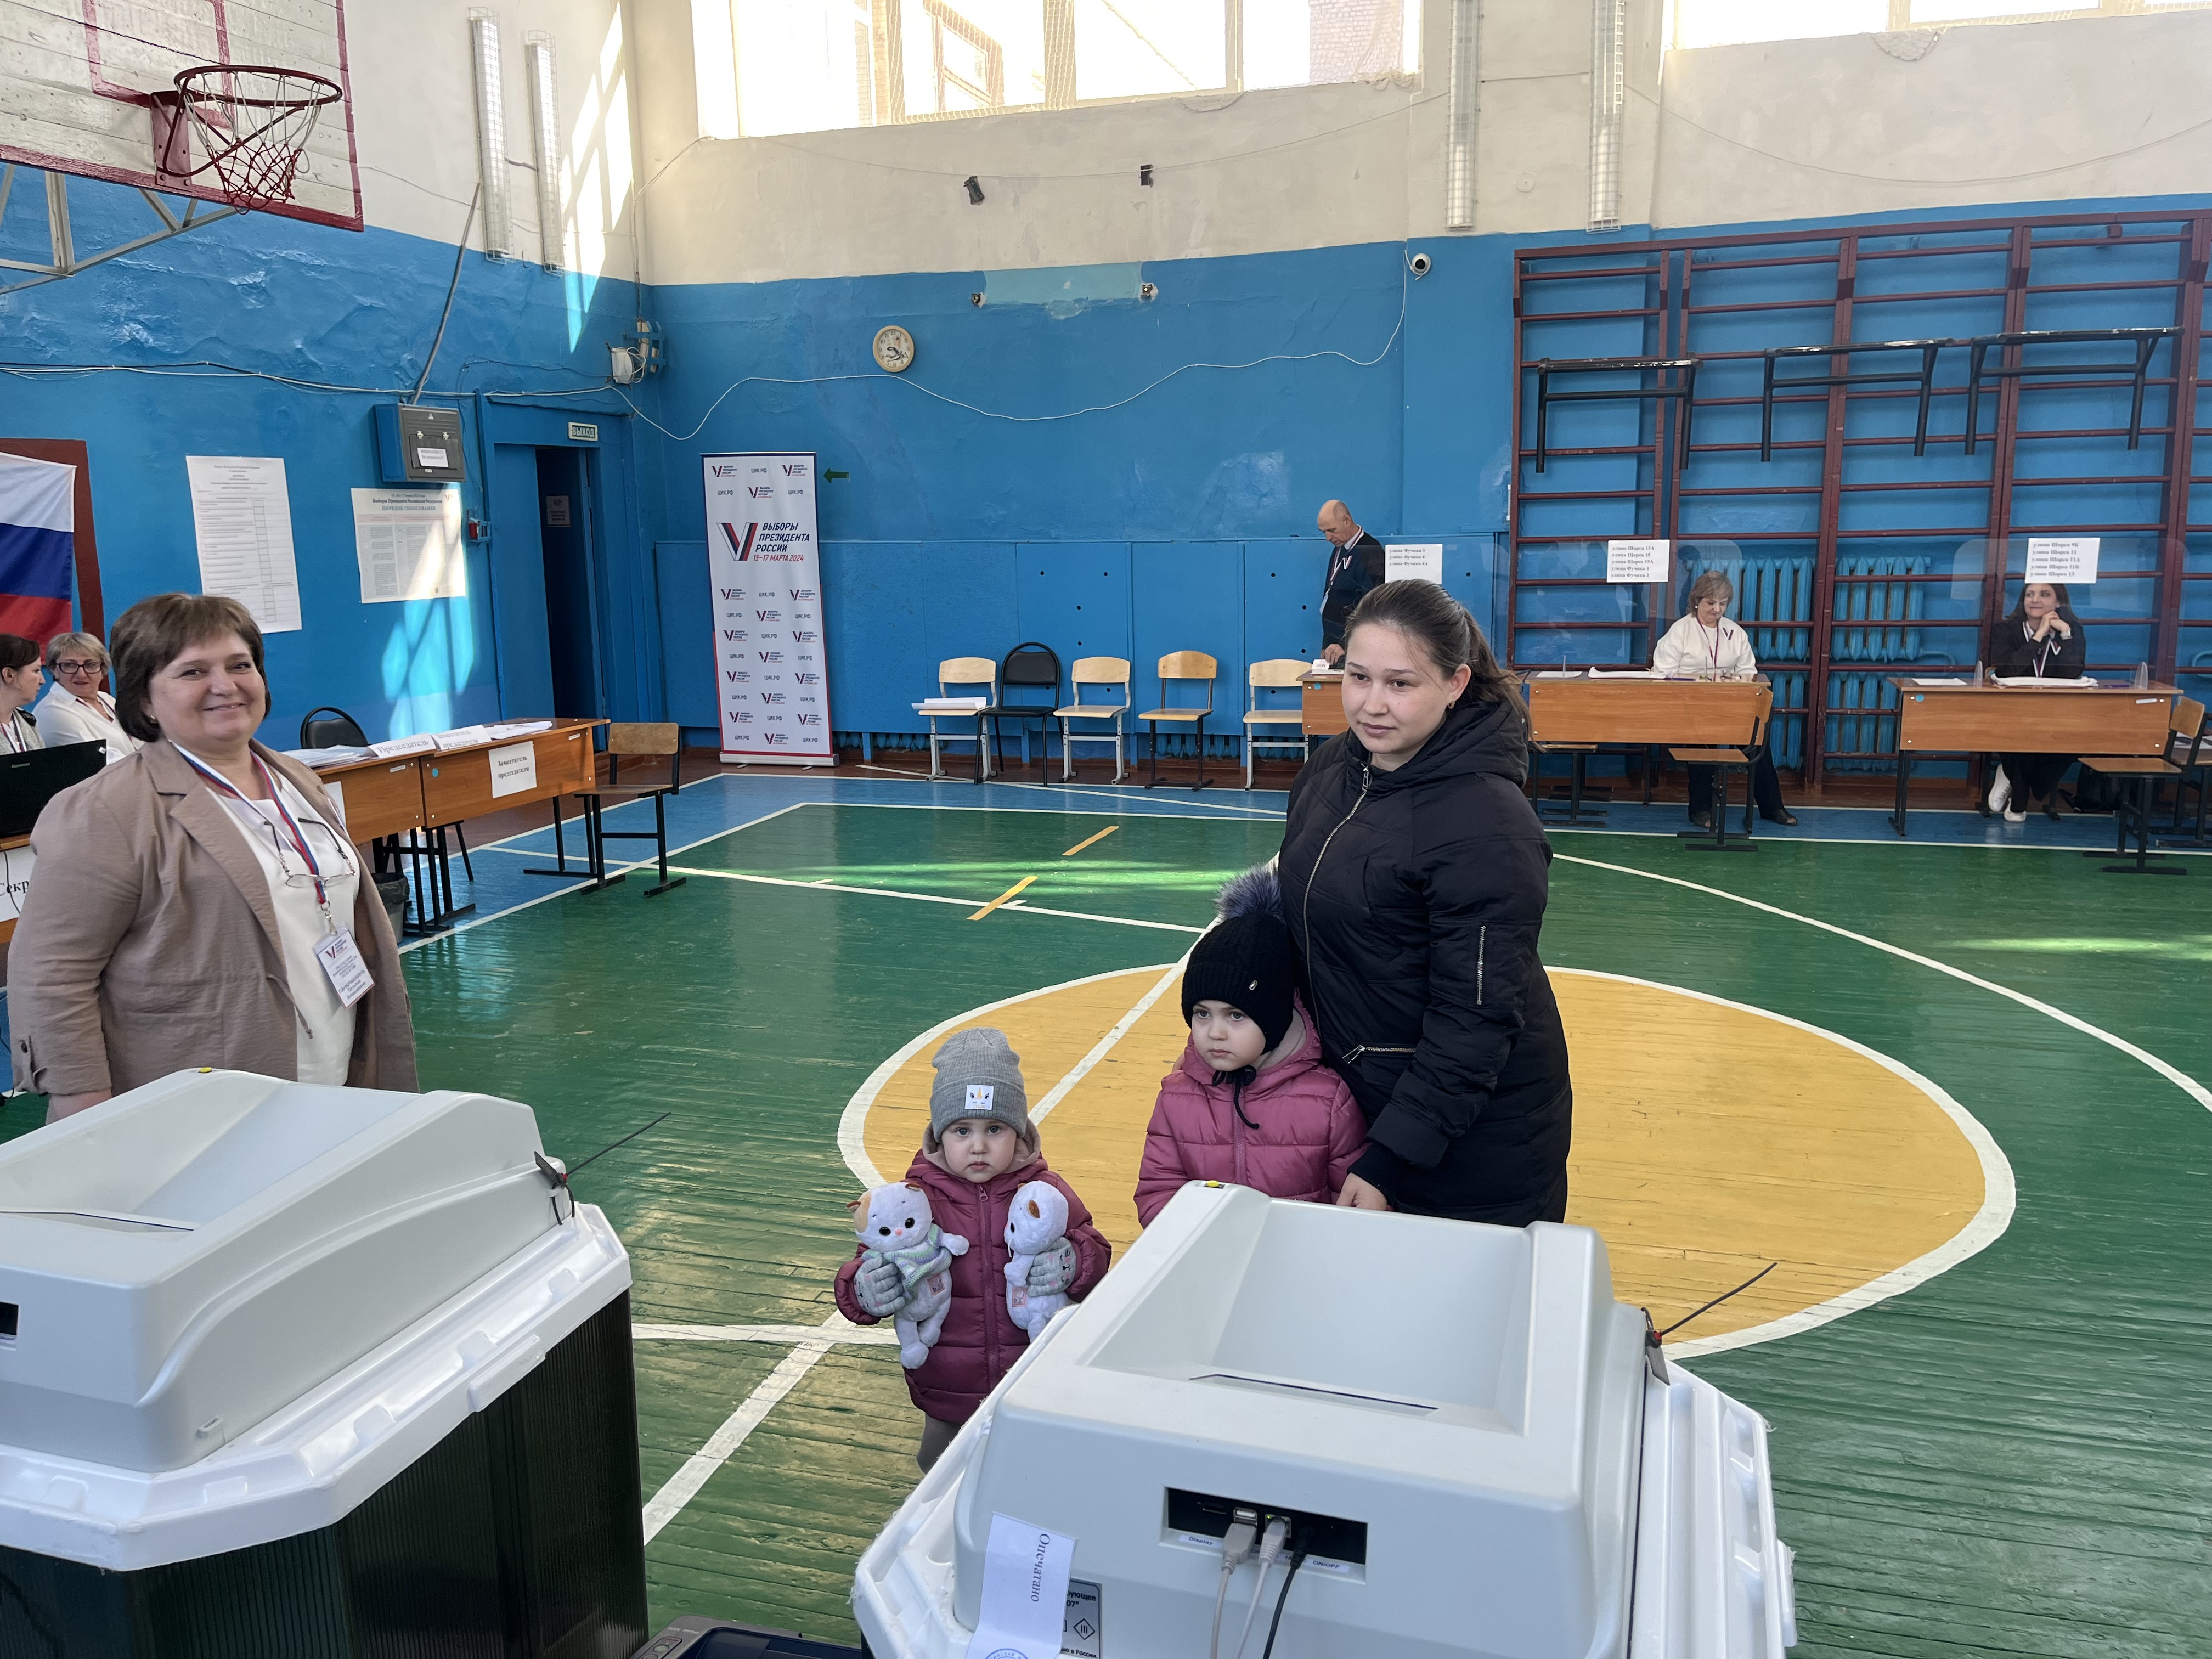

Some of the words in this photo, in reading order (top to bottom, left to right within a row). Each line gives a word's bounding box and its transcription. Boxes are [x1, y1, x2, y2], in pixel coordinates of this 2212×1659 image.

[572, 426, 595, 437] ВЫХОД
[763, 522, 799, 531] ВЫБОРЫ
[759, 533, 810, 542] ПРЕЗИДЕНТА
[377, 740, 429, 754] Председатель
[497, 756, 528, 767] Заместитель
[498, 767, 529, 780] председателя
[1188, 1536, 1214, 1545] Display
[1031, 1533, 1051, 1602] Опечатано
[1312, 1560, 1340, 1569] ON/OFF
